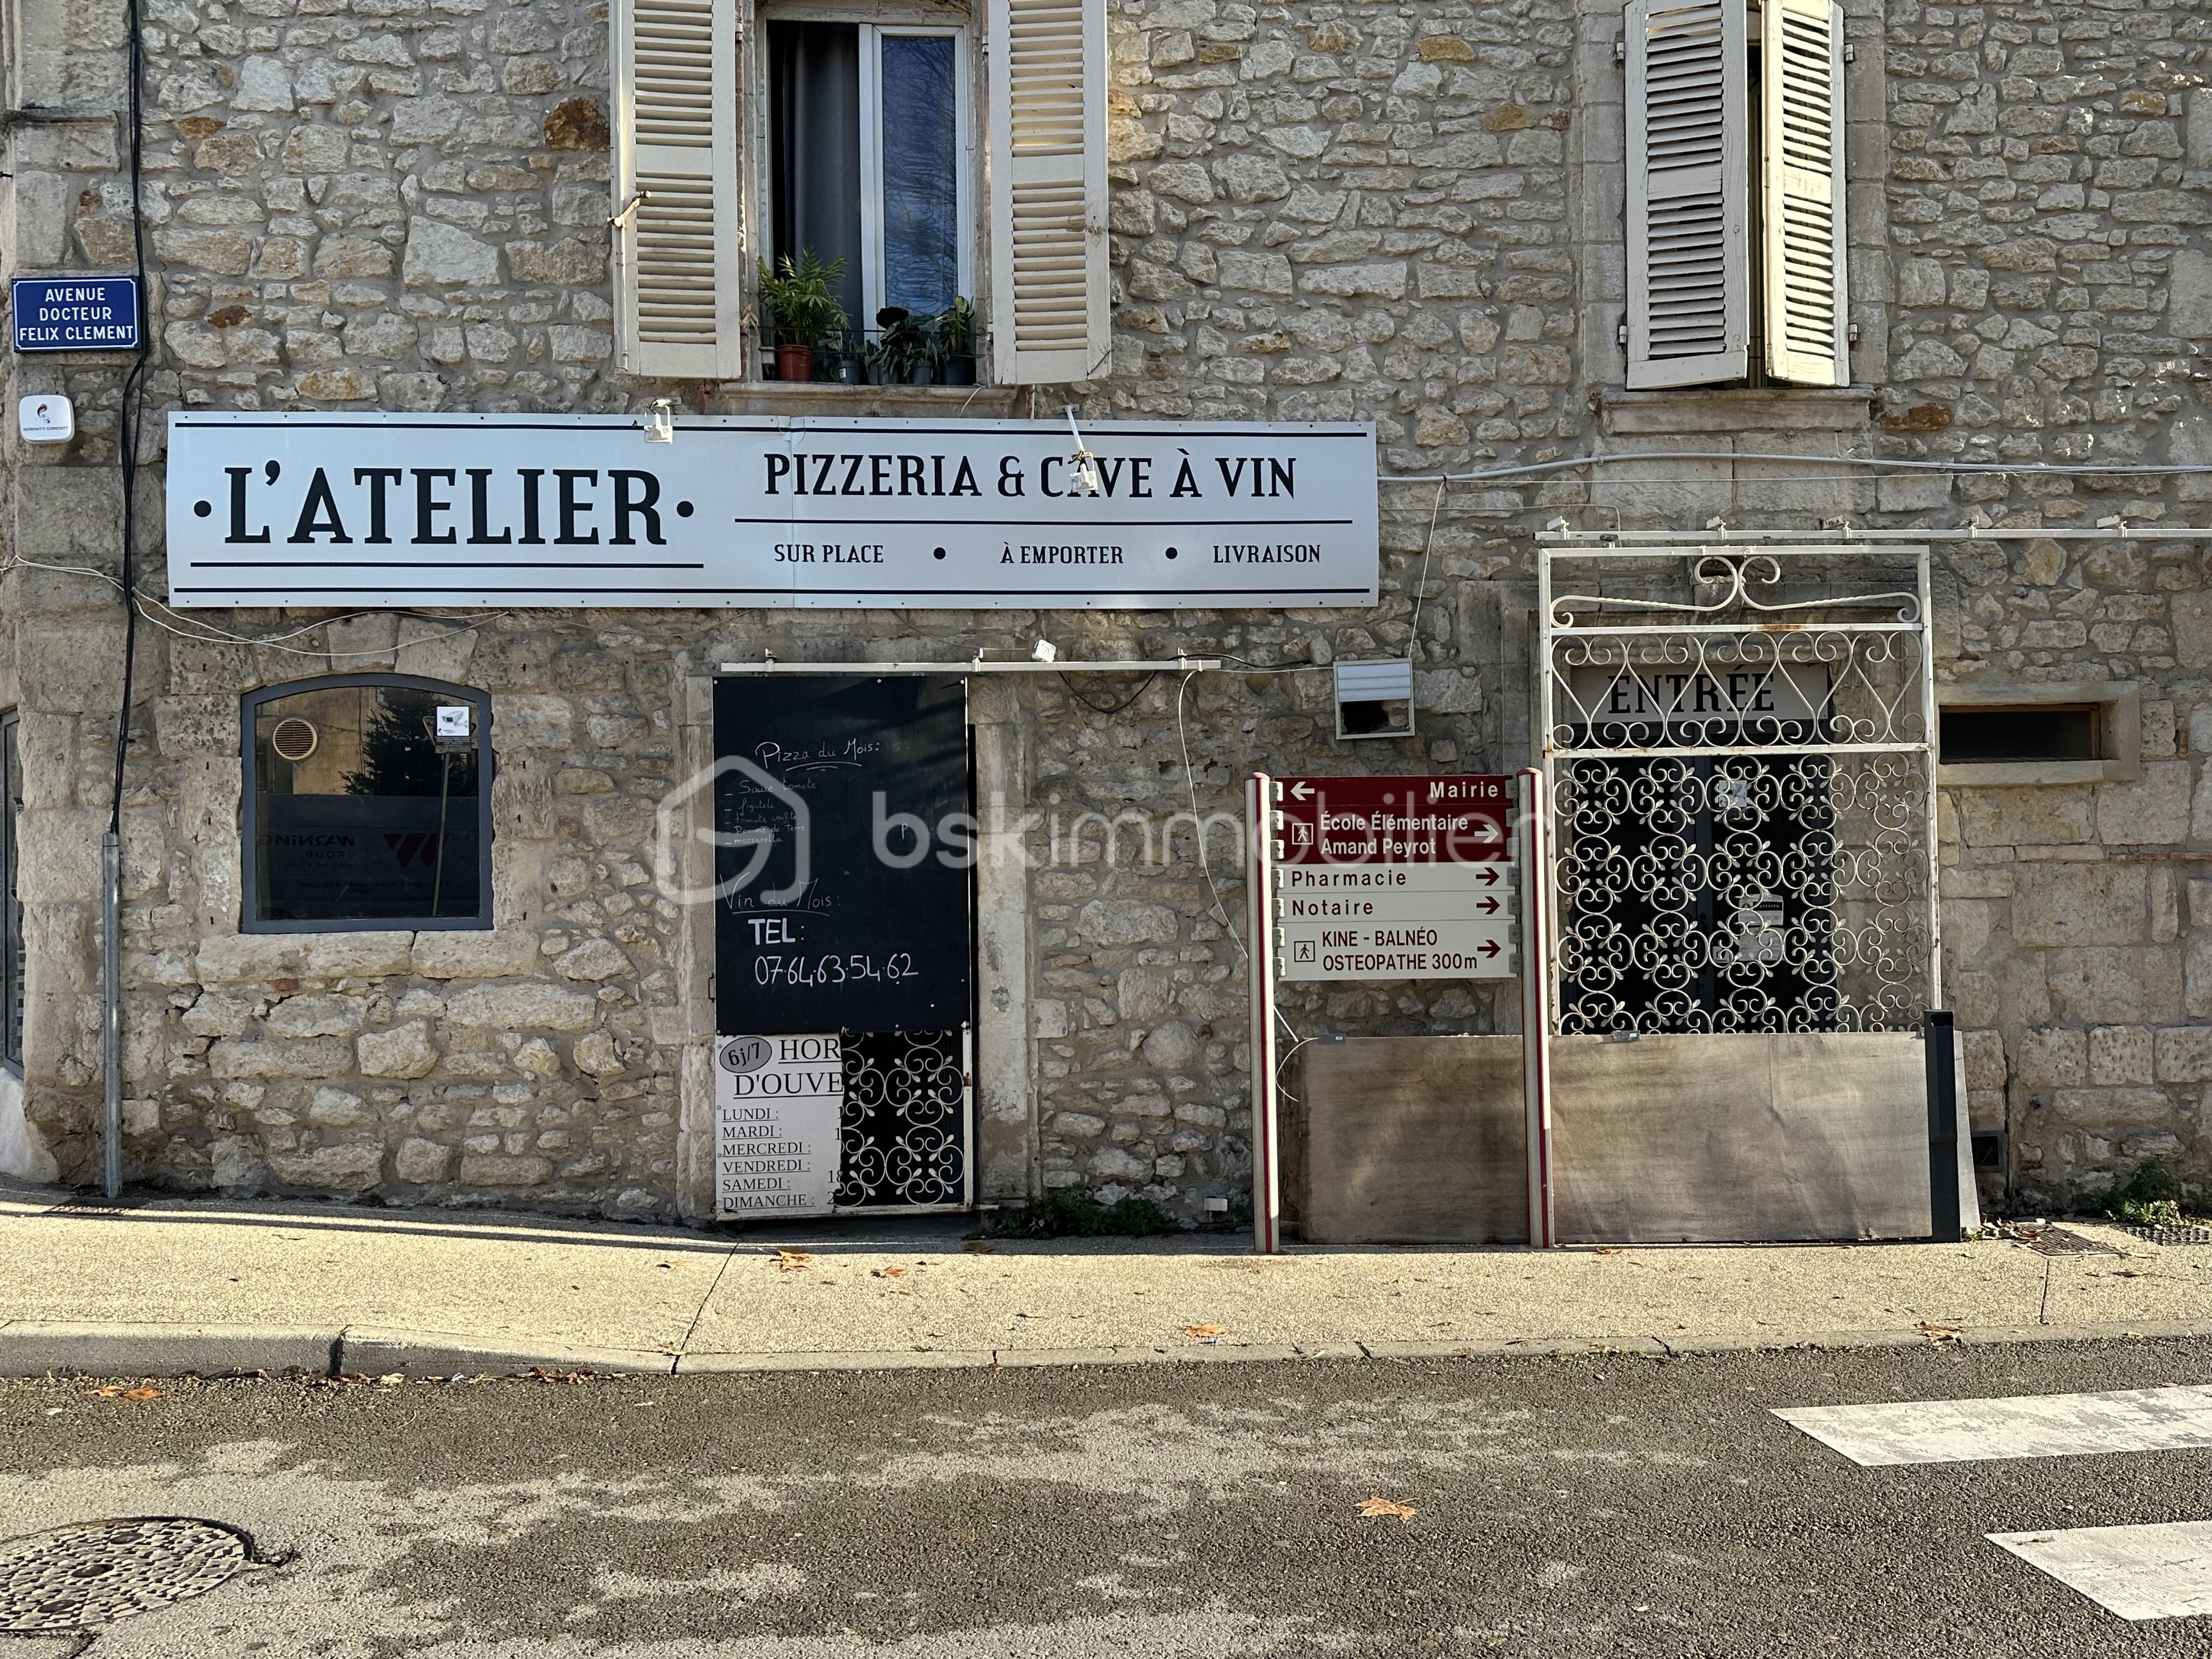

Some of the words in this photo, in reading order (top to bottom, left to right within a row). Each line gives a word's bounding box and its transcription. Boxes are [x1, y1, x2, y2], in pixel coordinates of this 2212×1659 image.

[45, 287, 106, 302] AVENUE
[39, 307, 112, 321] DOCTEUR
[20, 327, 59, 341] FELIX
[65, 325, 133, 340] CLEMENT
[764, 454, 982, 496] PIZZERIA
[997, 455, 1025, 497] &
[1169, 448, 1203, 497] À
[1215, 458, 1296, 499] VIN
[774, 544, 816, 562] SUR
[822, 544, 884, 563] PLACE
[1000, 541, 1014, 563] À
[1020, 545, 1124, 564] EMPORTER
[1213, 544, 1321, 563] LIVRAISON
[1607, 664, 1775, 714] ENTRÉE
[755, 741, 810, 769] Pizza
[818, 741, 837, 758] du
[738, 779, 774, 795] Sauce
[782, 777, 817, 791] tomate
[1430, 781, 1498, 798] Mairie
[1321, 810, 1365, 831] École
[1371, 810, 1469, 831] Élémentaire
[733, 833, 783, 844] mozzarella
[1321, 838, 1378, 855] Amand
[1383, 837, 1436, 859] Peyrot
[1291, 870, 1407, 887] Pharmacie
[719, 871, 755, 909] Vin
[768, 881, 788, 907] du
[1292, 899, 1374, 916] Notaire
[1322, 930, 1358, 947] KINE
[1375, 926, 1438, 946] BALNÉO
[1323, 953, 1427, 971] OSTEOPATHE
[727, 1041, 762, 1068] 6j/7
[780, 1037, 841, 1061] HOR
[733, 1071, 843, 1097] D'OUVE
[723, 1108, 771, 1121] LUNDI
[723, 1125, 775, 1139] MARDI
[723, 1142, 804, 1156] MERCREDI
[723, 1159, 803, 1174] VENDREDI
[723, 1177, 783, 1191] SAMEDI
[724, 1194, 807, 1208] DIMANCHE
